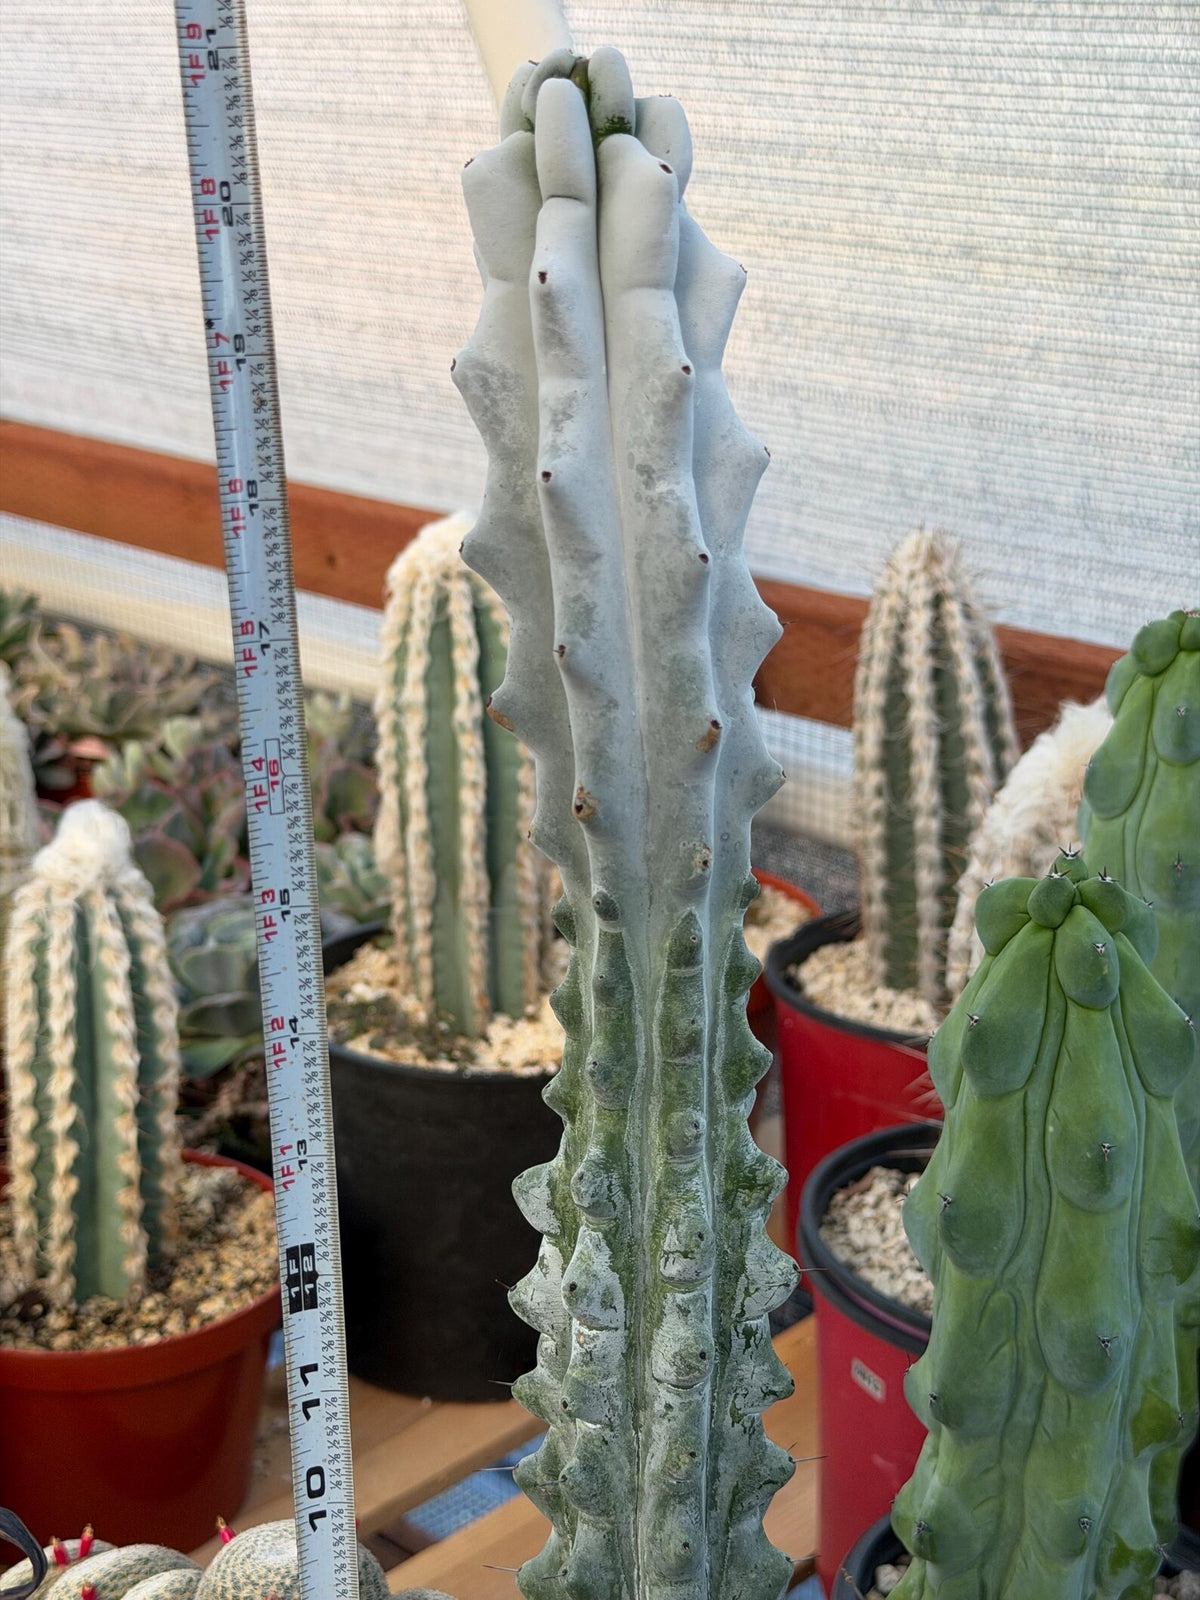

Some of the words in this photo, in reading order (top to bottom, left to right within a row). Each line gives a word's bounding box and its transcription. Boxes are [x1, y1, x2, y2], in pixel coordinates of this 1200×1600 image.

[186, 23, 202, 39] 9
[206, 28, 219, 71] 21
[189, 54, 205, 86] 1F
[201, 179, 216, 195] 8
[220, 180, 234, 227] 20
[204, 209, 219, 241] 1F
[215, 332, 230, 348] 7
[234, 334, 246, 372] 19
[218, 361, 233, 391] 1F
[229, 478, 243, 494] 6
[247, 480, 259, 517] 18
[231, 507, 246, 538] 1F
[240, 621, 255, 636] 5
[259, 621, 270, 656] 17
[242, 648, 257, 677] 1F
[252, 757, 265, 771] 4
[269, 759, 280, 792] 16
[254, 785, 268, 812] 1F
[261, 889, 275, 904] 3
[280, 888, 291, 922] 15
[264, 915, 278, 941] 1F
[271, 1016, 284, 1031] 2
[289, 1015, 300, 1049] 14
[273, 1042, 287, 1068] 1F
[280, 1145, 293, 1155] 1
[297, 1139, 307, 1170] 13
[281, 1165, 295, 1189] 1F
[289, 1259, 300, 1298] 1F
[303, 1255, 314, 1294] 12
[300, 1362, 321, 1420] 11
[306, 1466, 327, 1532] 10
